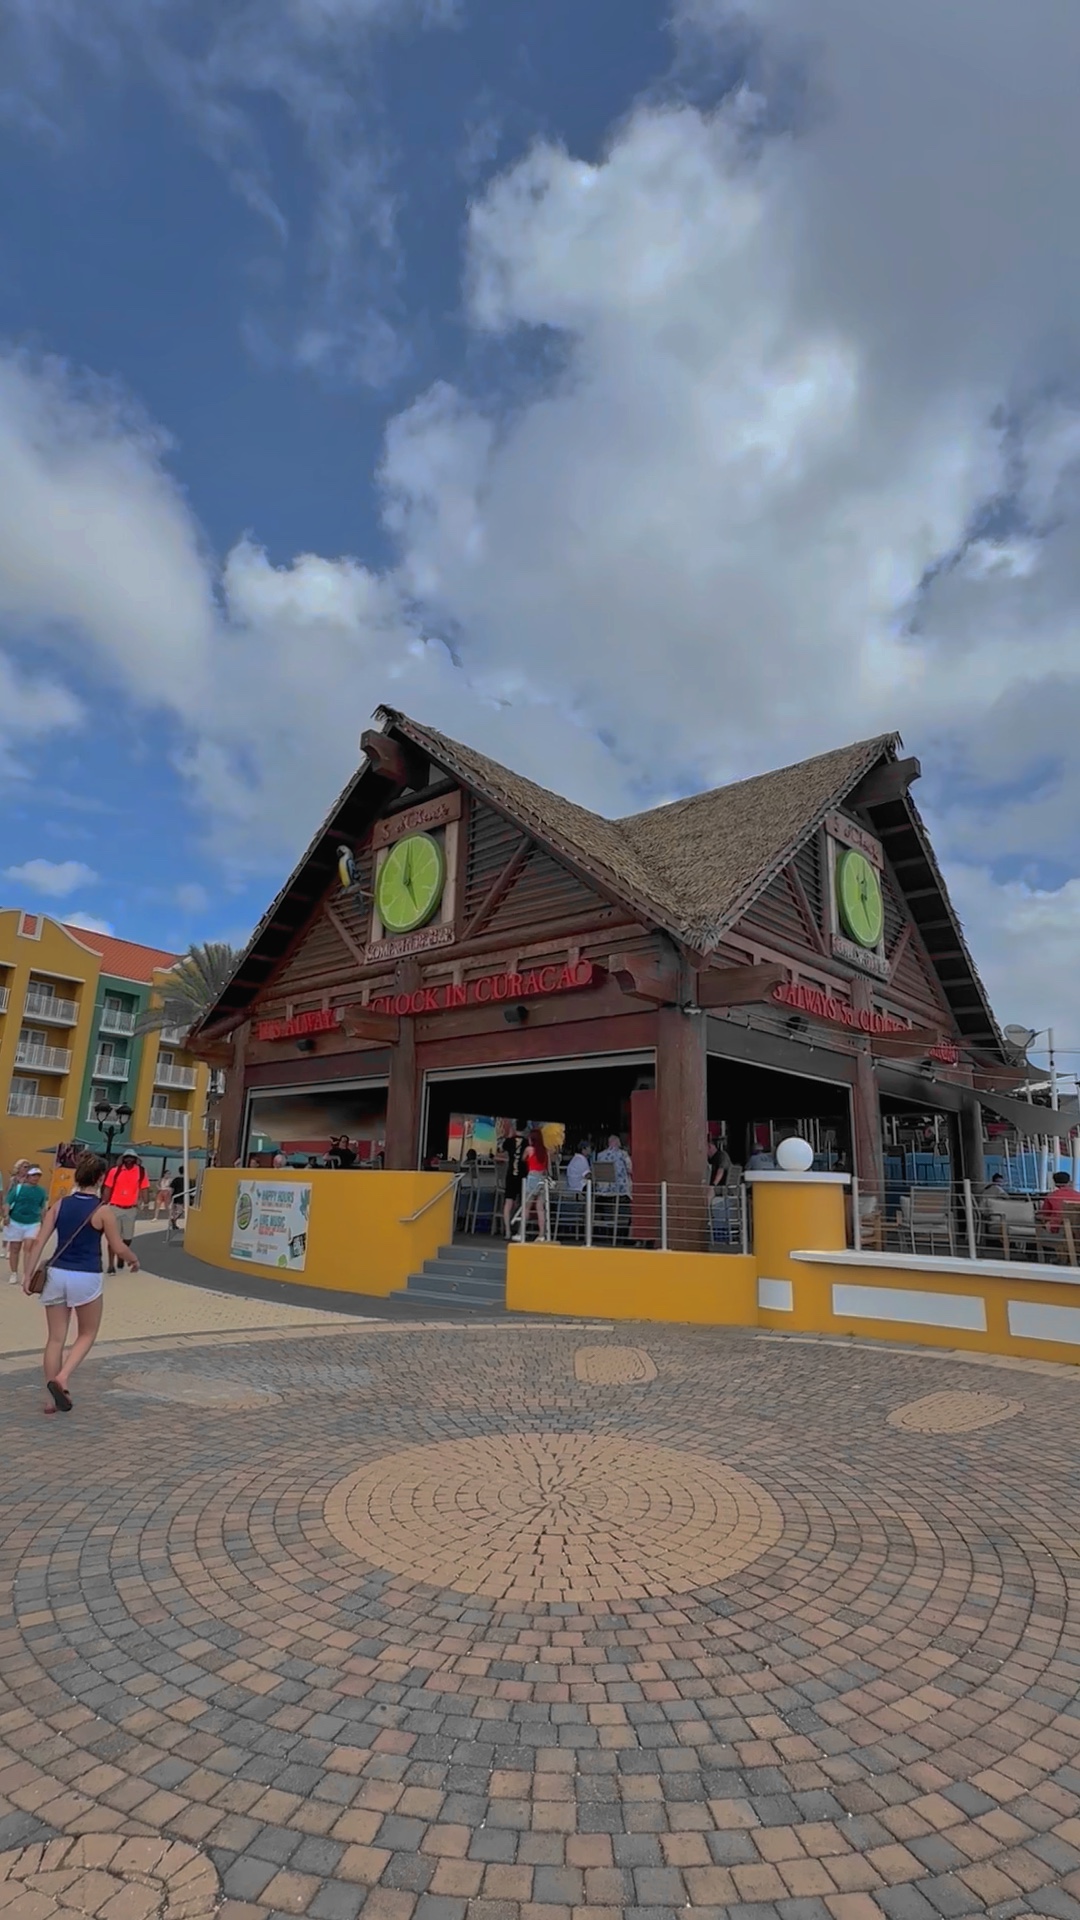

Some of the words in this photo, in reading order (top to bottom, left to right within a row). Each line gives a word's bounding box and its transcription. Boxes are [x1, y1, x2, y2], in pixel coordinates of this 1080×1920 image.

[445, 982, 468, 1007] IN
[787, 984, 837, 1020] ALWAYS
[277, 1190, 294, 1203] HOURS
